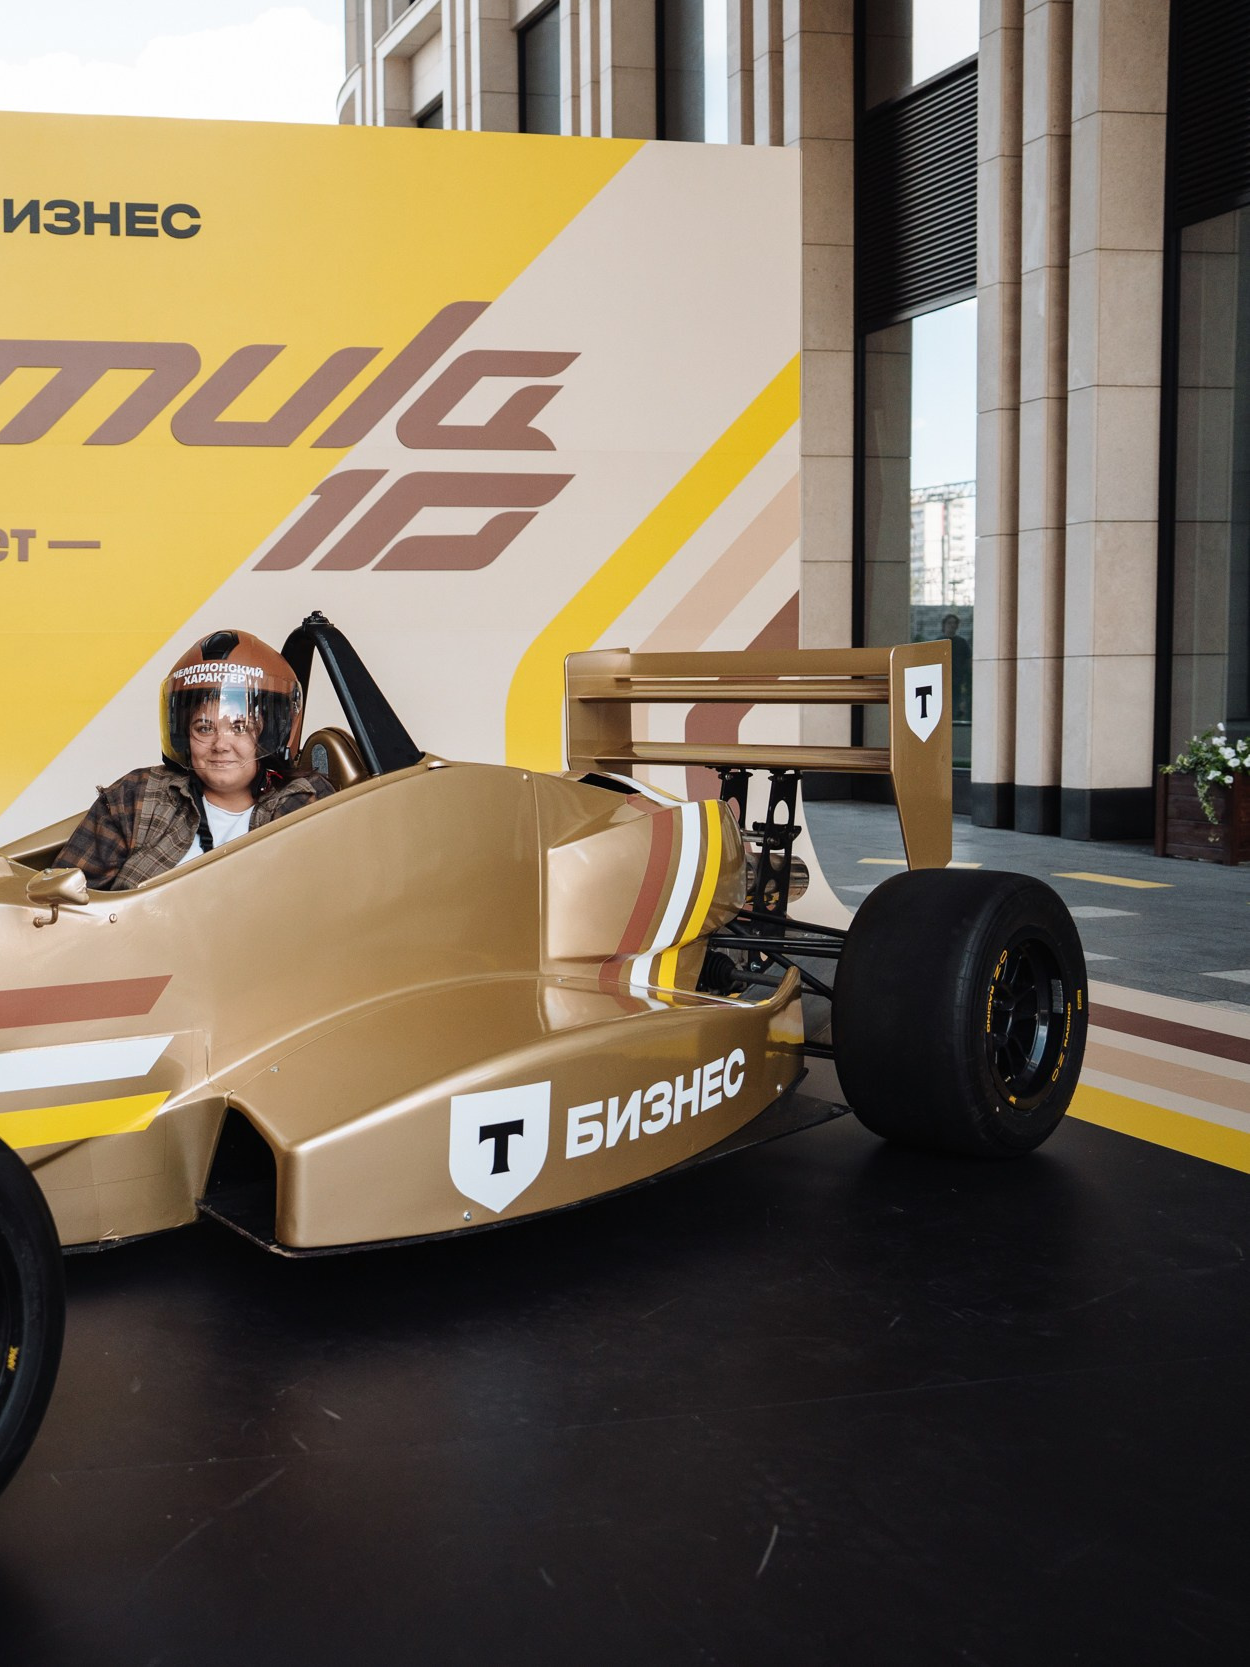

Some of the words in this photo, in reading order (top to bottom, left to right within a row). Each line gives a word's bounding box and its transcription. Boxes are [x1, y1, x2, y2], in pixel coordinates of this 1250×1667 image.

[251, 468, 576, 572] 10
[173, 662, 264, 680] ЧЕМПИОНСКИЙ
[182, 672, 246, 686] ХАРАКТЕР
[986, 985, 995, 1033] RACING
[1063, 1002, 1071, 1047] RACING
[565, 1047, 746, 1160] БИЗНЕС
